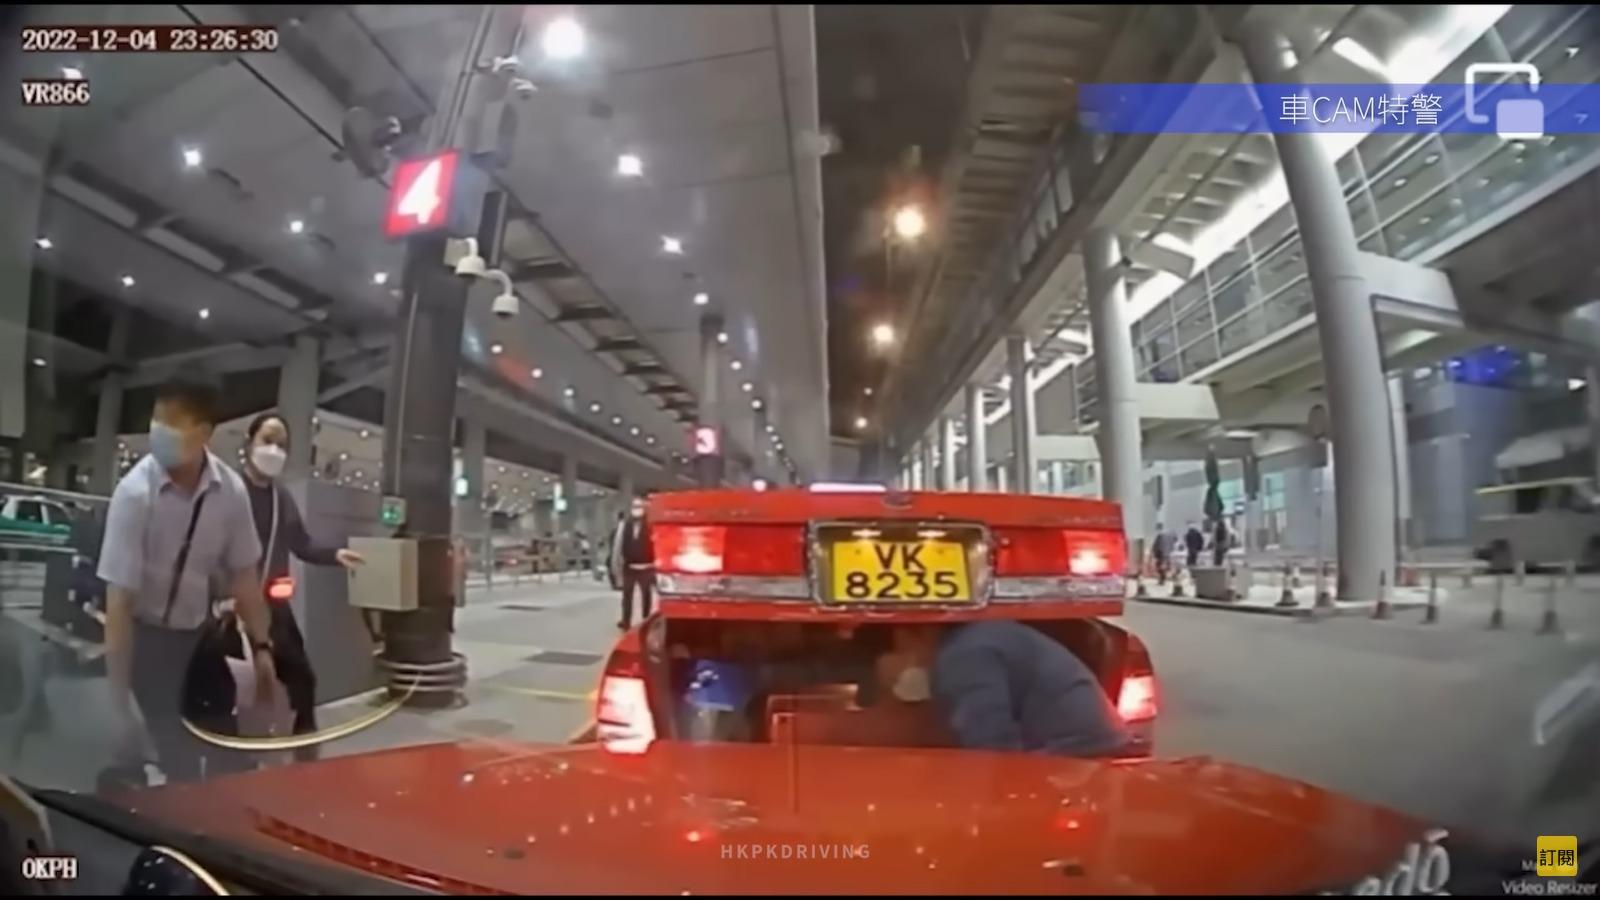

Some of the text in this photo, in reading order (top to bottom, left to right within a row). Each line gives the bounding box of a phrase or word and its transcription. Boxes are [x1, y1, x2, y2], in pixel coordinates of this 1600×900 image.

[397, 159, 442, 224] 4
[696, 428, 715, 454] 3
[873, 544, 926, 570] VK
[845, 572, 959, 599] 8235
